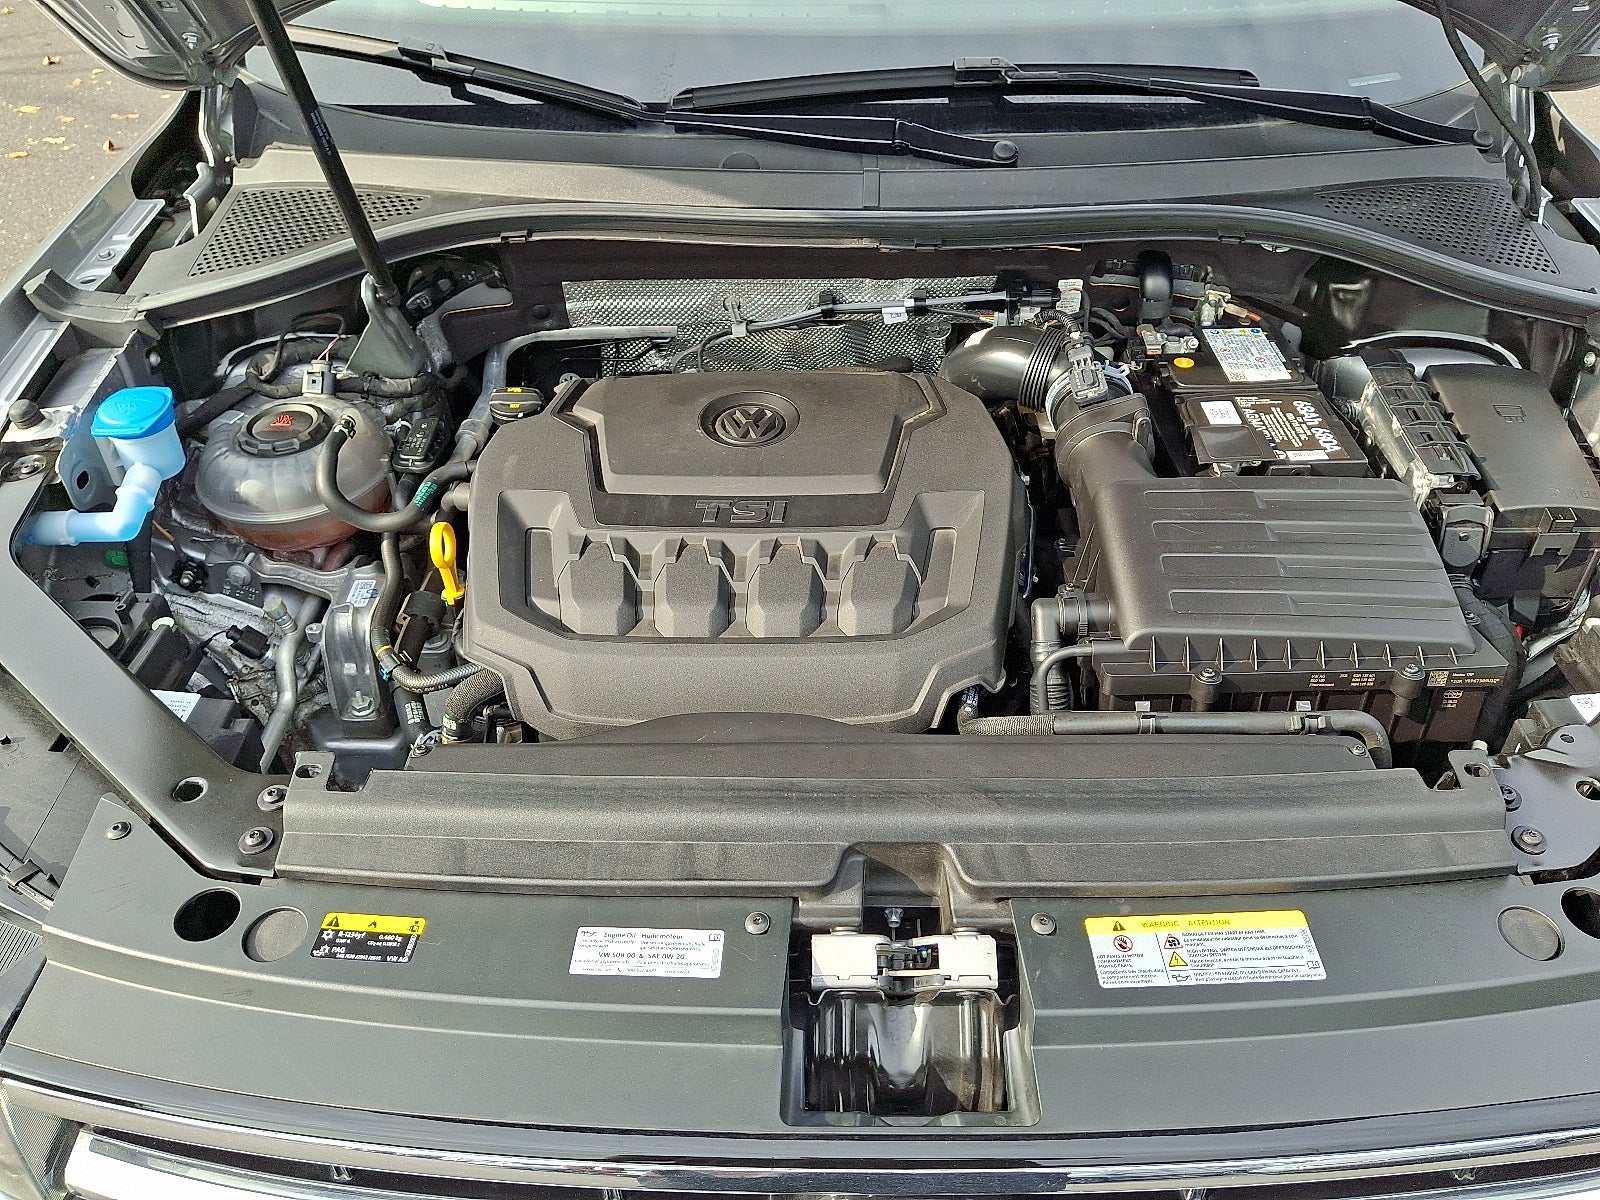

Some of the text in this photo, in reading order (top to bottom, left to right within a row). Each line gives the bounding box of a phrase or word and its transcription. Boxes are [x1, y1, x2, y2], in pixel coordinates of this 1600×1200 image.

[1293, 401, 1322, 425] 68Ah
[1311, 428, 1341, 452] 680A
[695, 500, 788, 523] TSI
[1141, 920, 1180, 928] WARNING
